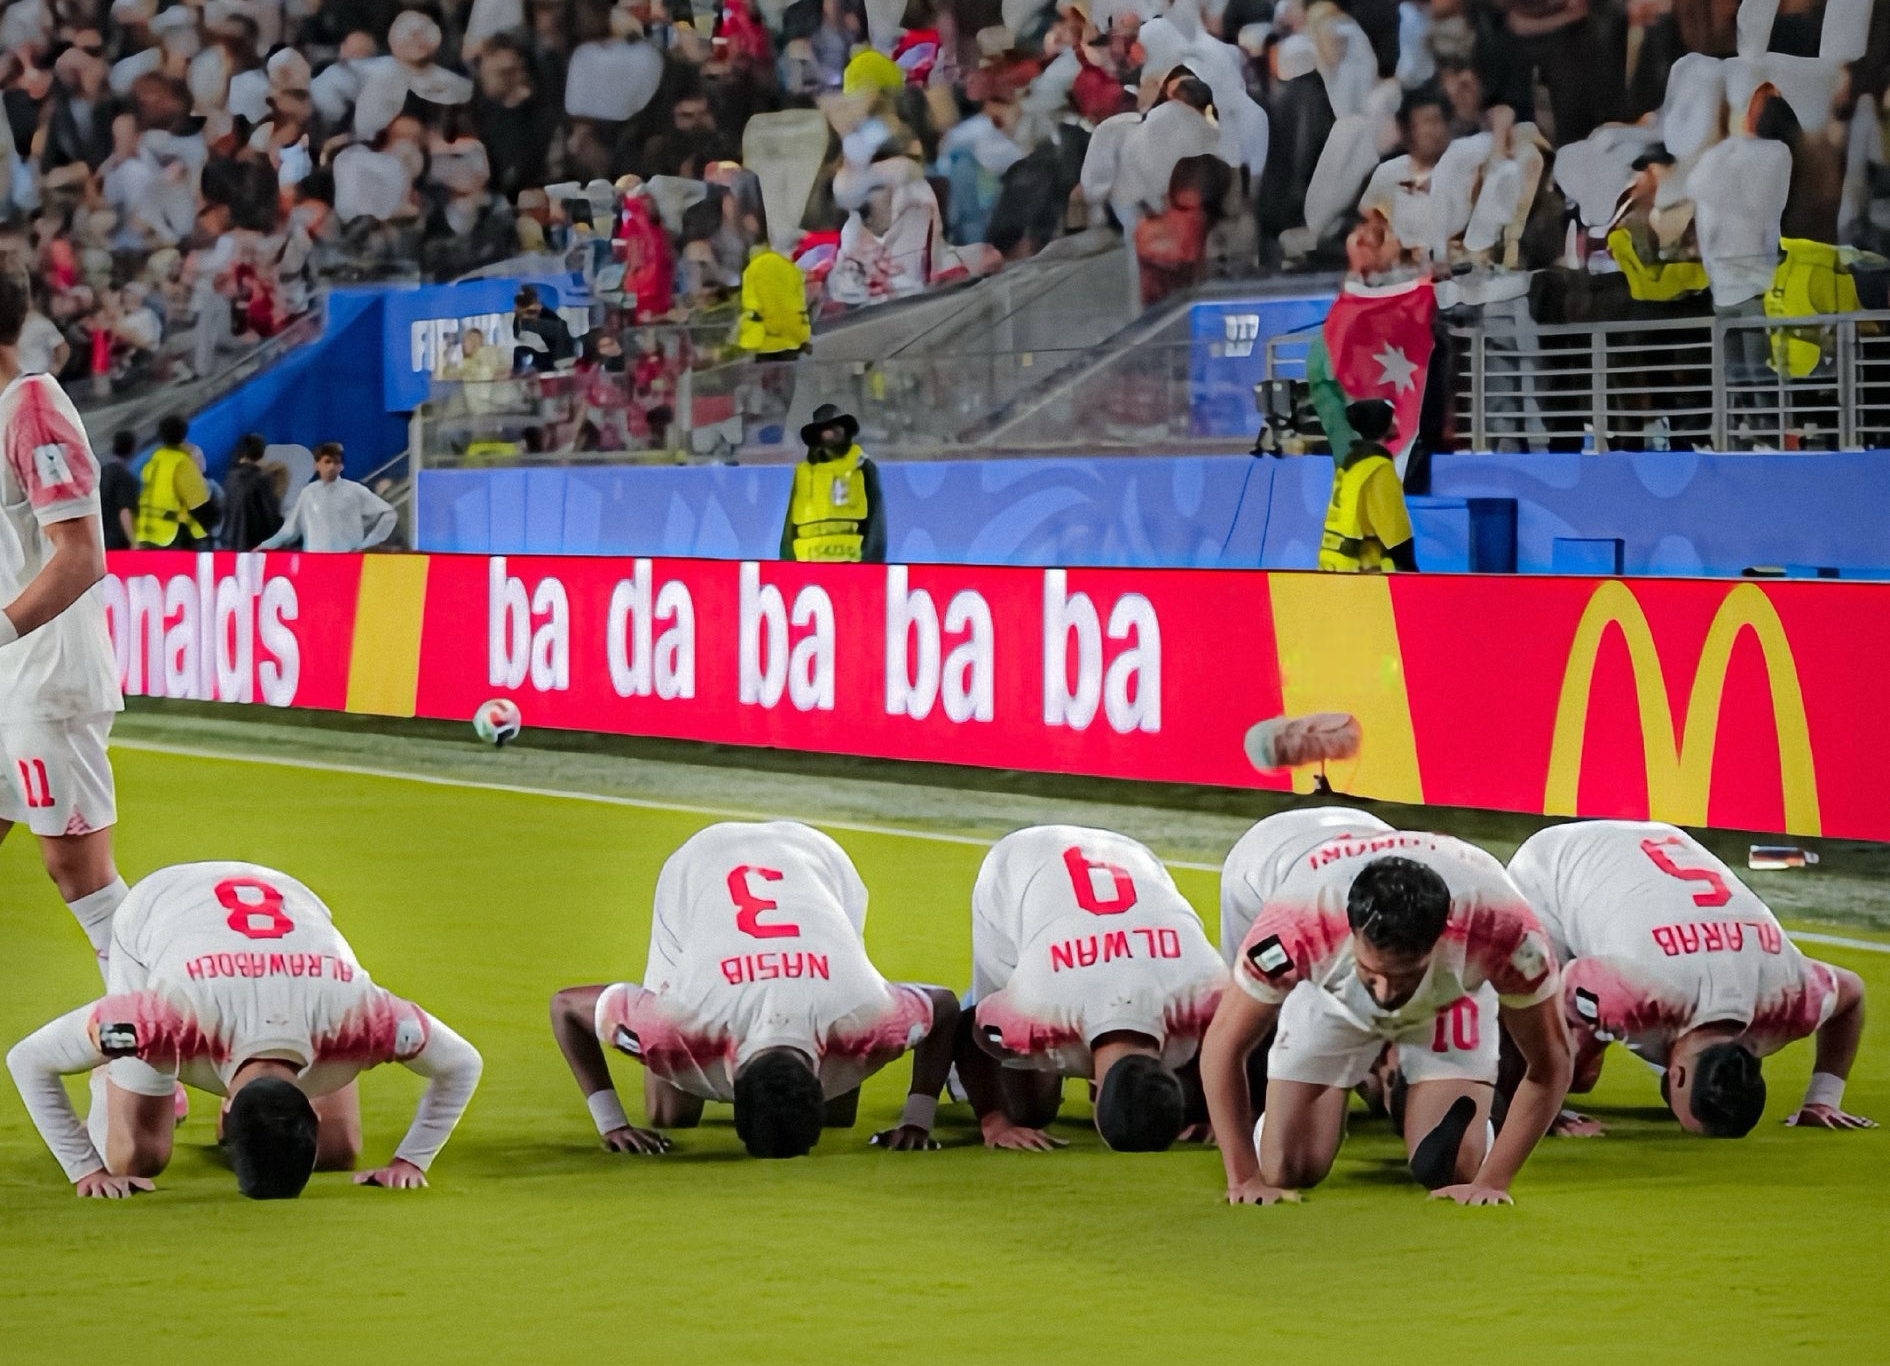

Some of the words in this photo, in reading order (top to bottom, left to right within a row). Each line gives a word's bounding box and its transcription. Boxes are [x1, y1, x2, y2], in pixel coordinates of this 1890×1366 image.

[489, 556, 570, 690] ba
[607, 558, 696, 699] da
[739, 561, 836, 711] ba
[886, 565, 995, 723] ba
[1043, 569, 1162, 733] ba
[18, 758, 56, 808] 11
[727, 864, 800, 939] 3
[1063, 846, 1138, 916] 9
[1639, 838, 1733, 908] 5
[213, 876, 295, 939] 8
[720, 951, 830, 985] NASIB
[1050, 928, 1181, 973] OLWAN
[1652, 921, 1782, 957] ALARAB
[1432, 996, 1480, 1053] 10
